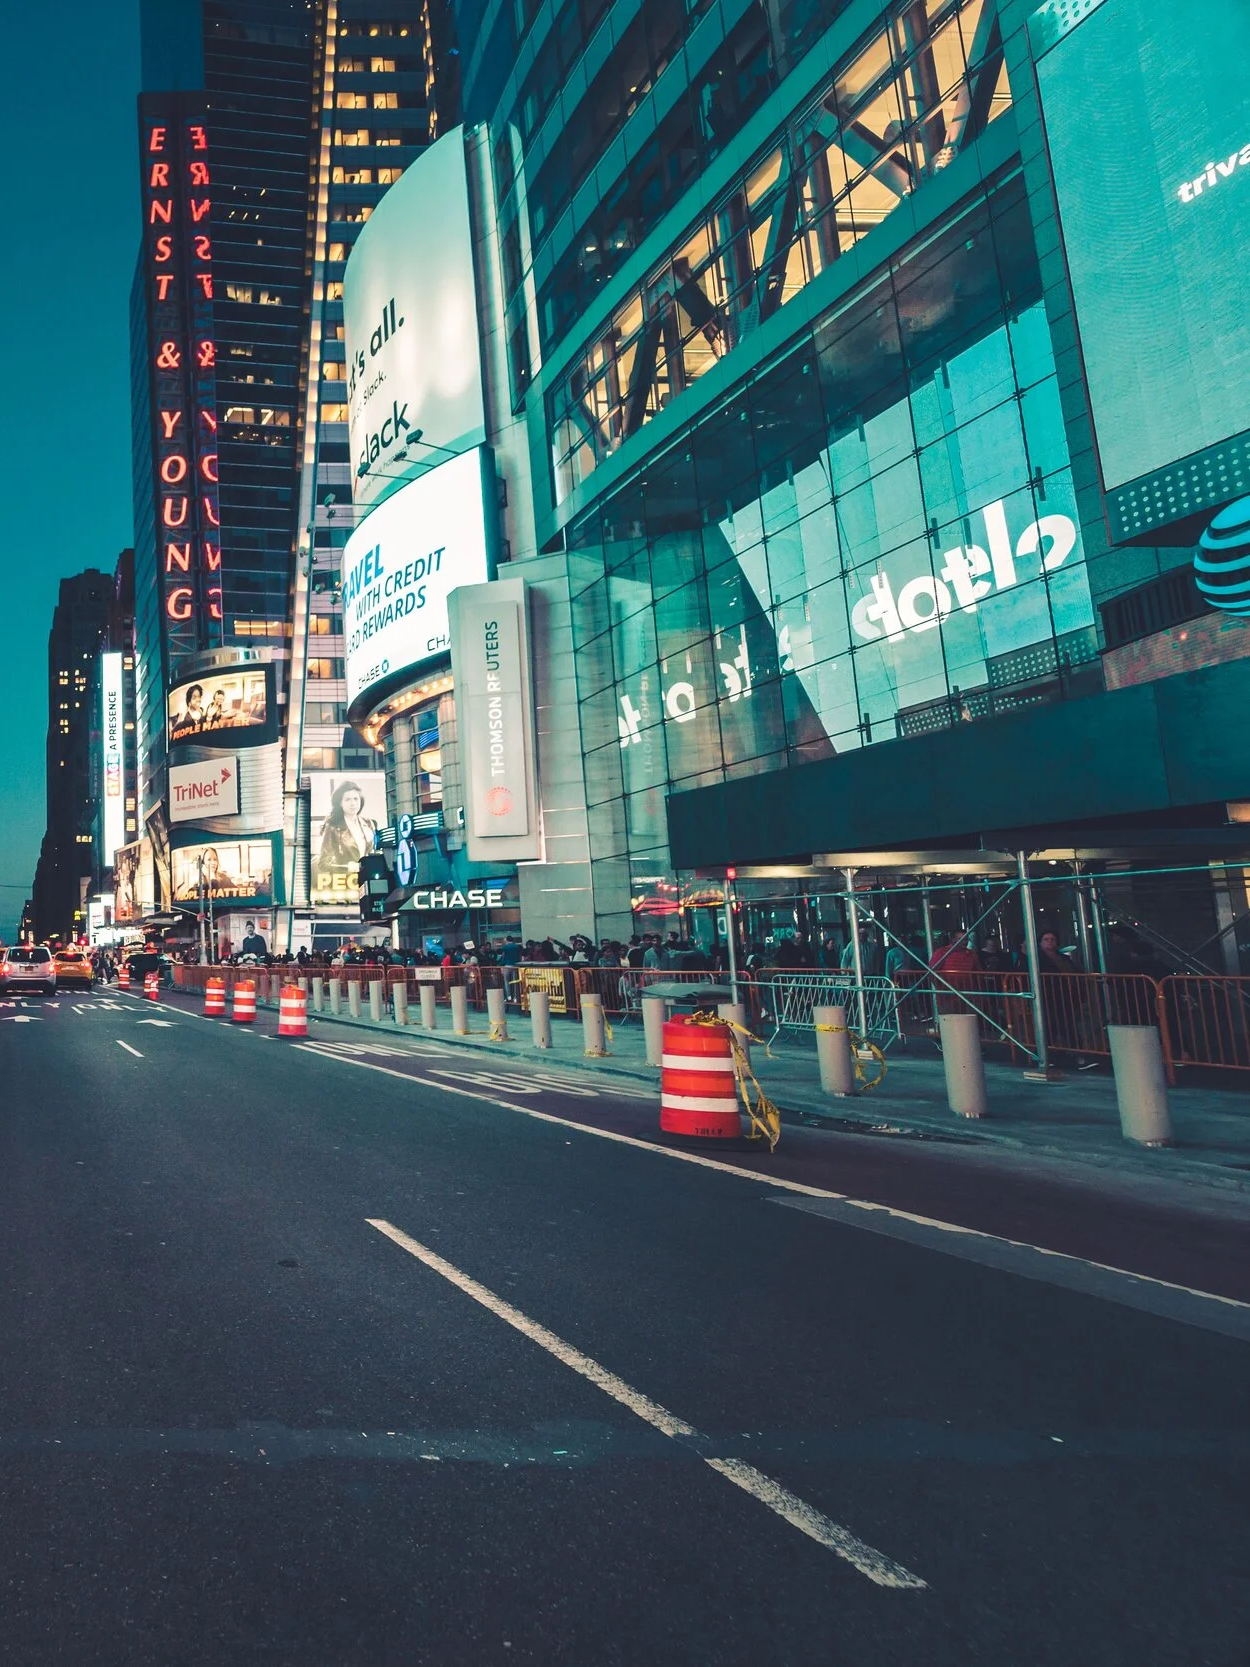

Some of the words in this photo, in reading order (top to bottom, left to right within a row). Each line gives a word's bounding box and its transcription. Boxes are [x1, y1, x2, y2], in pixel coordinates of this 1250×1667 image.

[150, 127, 174, 300] ERNST
[370, 297, 405, 357] all.
[156, 341, 181, 368] &
[161, 411, 193, 620] YOUNG
[356, 583, 380, 621] WITH
[384, 547, 446, 597] CREDIT
[363, 585, 426, 643] REWARDS
[108, 690, 117, 741] PRESENCE
[203, 718, 250, 732] MATTER
[489, 695, 506, 777] THOMSON
[173, 780, 219, 801] TriNet
[207, 887, 256, 898] MATTER
[413, 889, 504, 909] CHASE
